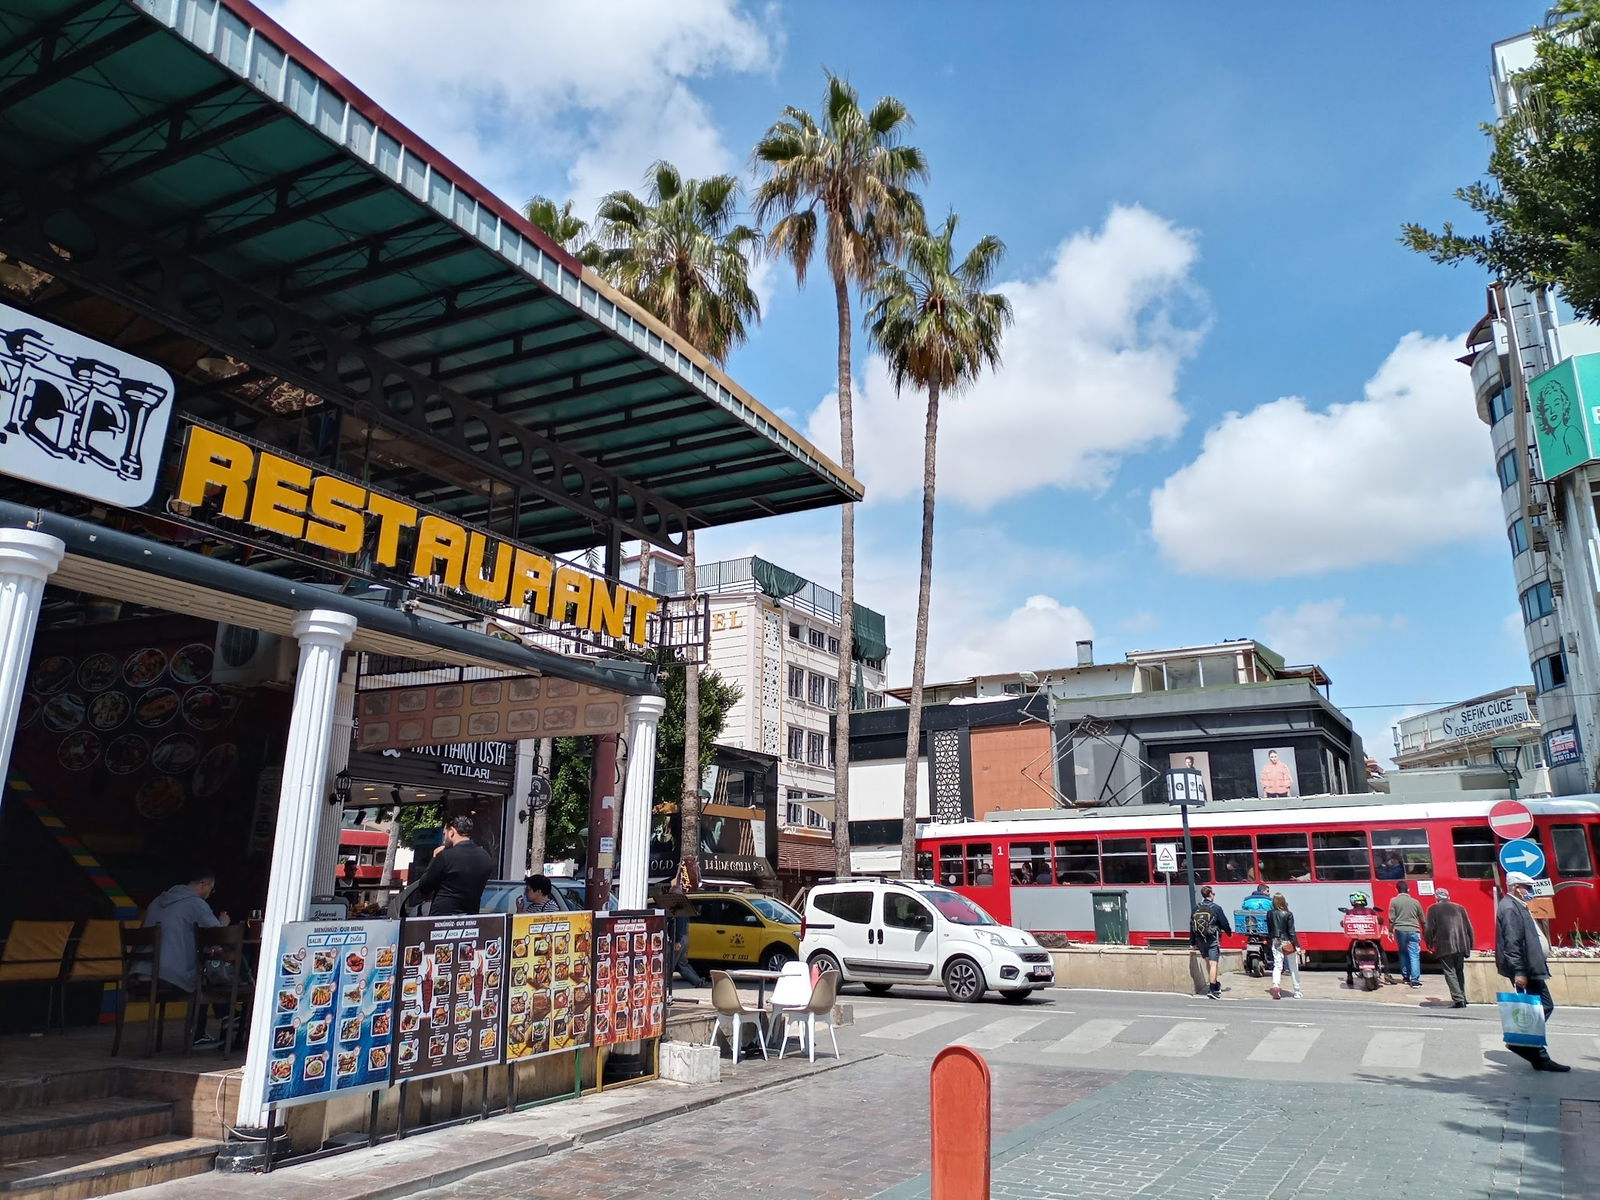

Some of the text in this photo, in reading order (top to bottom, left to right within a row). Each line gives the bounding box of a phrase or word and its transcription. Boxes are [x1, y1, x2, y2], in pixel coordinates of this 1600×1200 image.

[178, 425, 657, 645] RESTAURANT
[712, 610, 743, 632] EL
[1461, 699, 1512, 725] ŞEFİK CÜCE
[1455, 711, 1529, 737] ÖZEL ÖĞRETİM KURSU
[480, 741, 507, 766] USTA
[441, 763, 490, 779] TATLILARI
[997, 846, 1004, 856] 1
[651, 859, 674, 871] OLD
